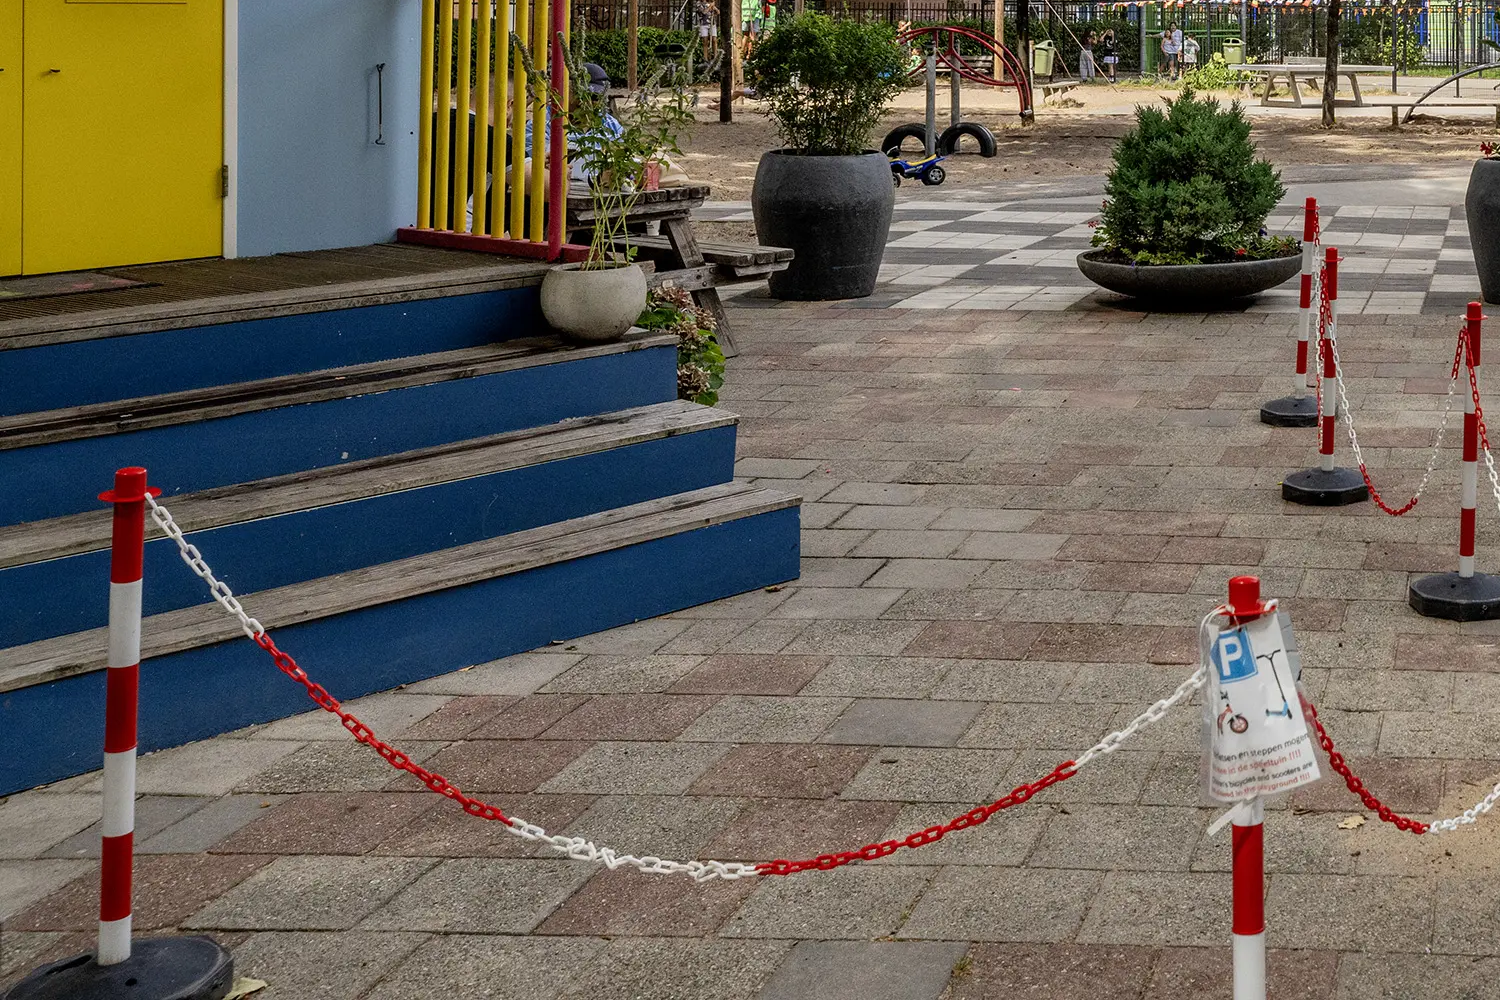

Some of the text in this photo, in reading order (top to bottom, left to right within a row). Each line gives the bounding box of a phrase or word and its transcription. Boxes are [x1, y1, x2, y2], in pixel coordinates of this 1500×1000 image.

[1219, 636, 1243, 677] P
[1238, 751, 1249, 759] en
[1250, 744, 1283, 758] steppen
[1284, 733, 1308, 747] mogen
[1229, 776, 1257, 788] bicycles
[1271, 767, 1301, 779] scooters
[1302, 762, 1313, 770] are
[1237, 764, 1248, 772] de
[1250, 757, 1287, 770] speeltuin
